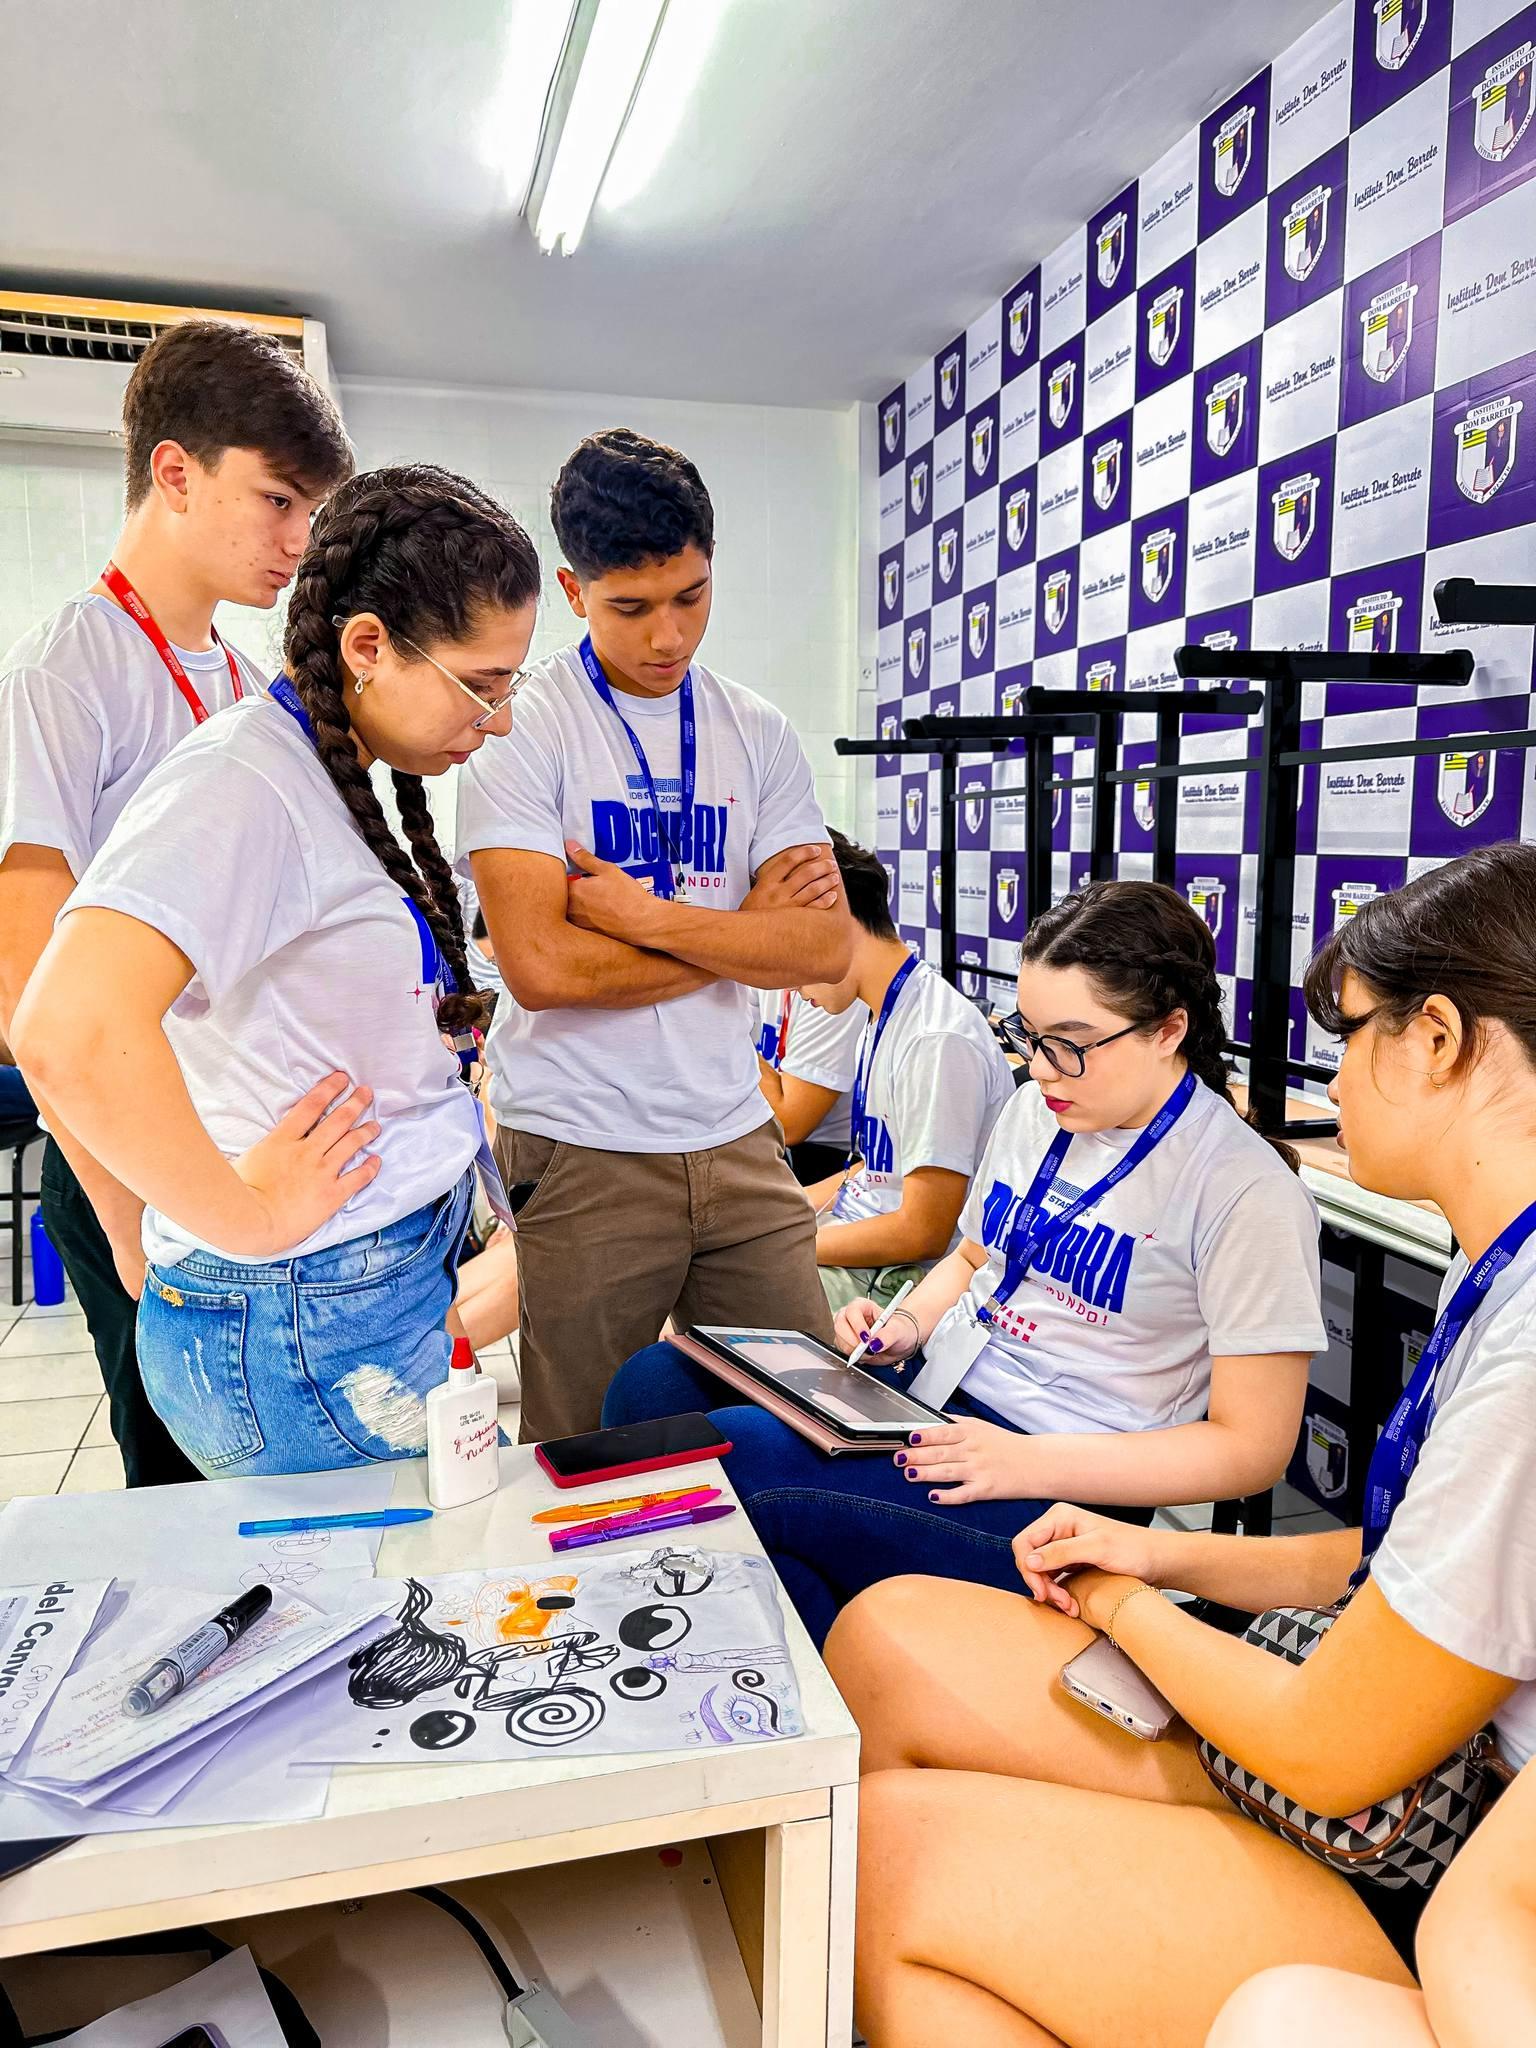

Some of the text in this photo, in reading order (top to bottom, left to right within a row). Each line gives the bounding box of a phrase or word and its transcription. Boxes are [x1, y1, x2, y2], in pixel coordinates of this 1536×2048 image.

[1482, 49, 1534, 91] DOM BARRETO
[1492, 46, 1524, 74] INSTITUTO
[1353, 180, 1382, 208] Instituto
[1385, 166, 1404, 187] Dom
[1407, 144, 1437, 173] Barreto
[1376, 285, 1402, 303] INSTITUTO
[1447, 283, 1481, 309] Instituto
[1486, 272, 1506, 290] Dom
[1511, 257, 1536, 278] Barr
[1368, 290, 1410, 318] DOM BARRETO
[1463, 405, 1513, 431] DOM BARRETO
[1473, 399, 1504, 416] INSTITUTO
[1340, 485, 1368, 505] Instituto
[1371, 480, 1388, 494] Dom
[1392, 466, 1421, 487] Barreto
[1354, 601, 1395, 616] DOM BARRETO
[281, 695, 299, 712] START
[1326, 772, 1404, 788] Instituto Dom Barreto
[630, 792, 642, 800] IDB
[1048, 1195, 1074, 1211] STAR
[1472, 1246, 1503, 1288] IDB START
[1392, 1427, 1402, 1442] IDB
[1398, 1400, 1413, 1428] START
[1381, 1489, 1392, 1514] START
[34, 1580, 74, 1615] del
